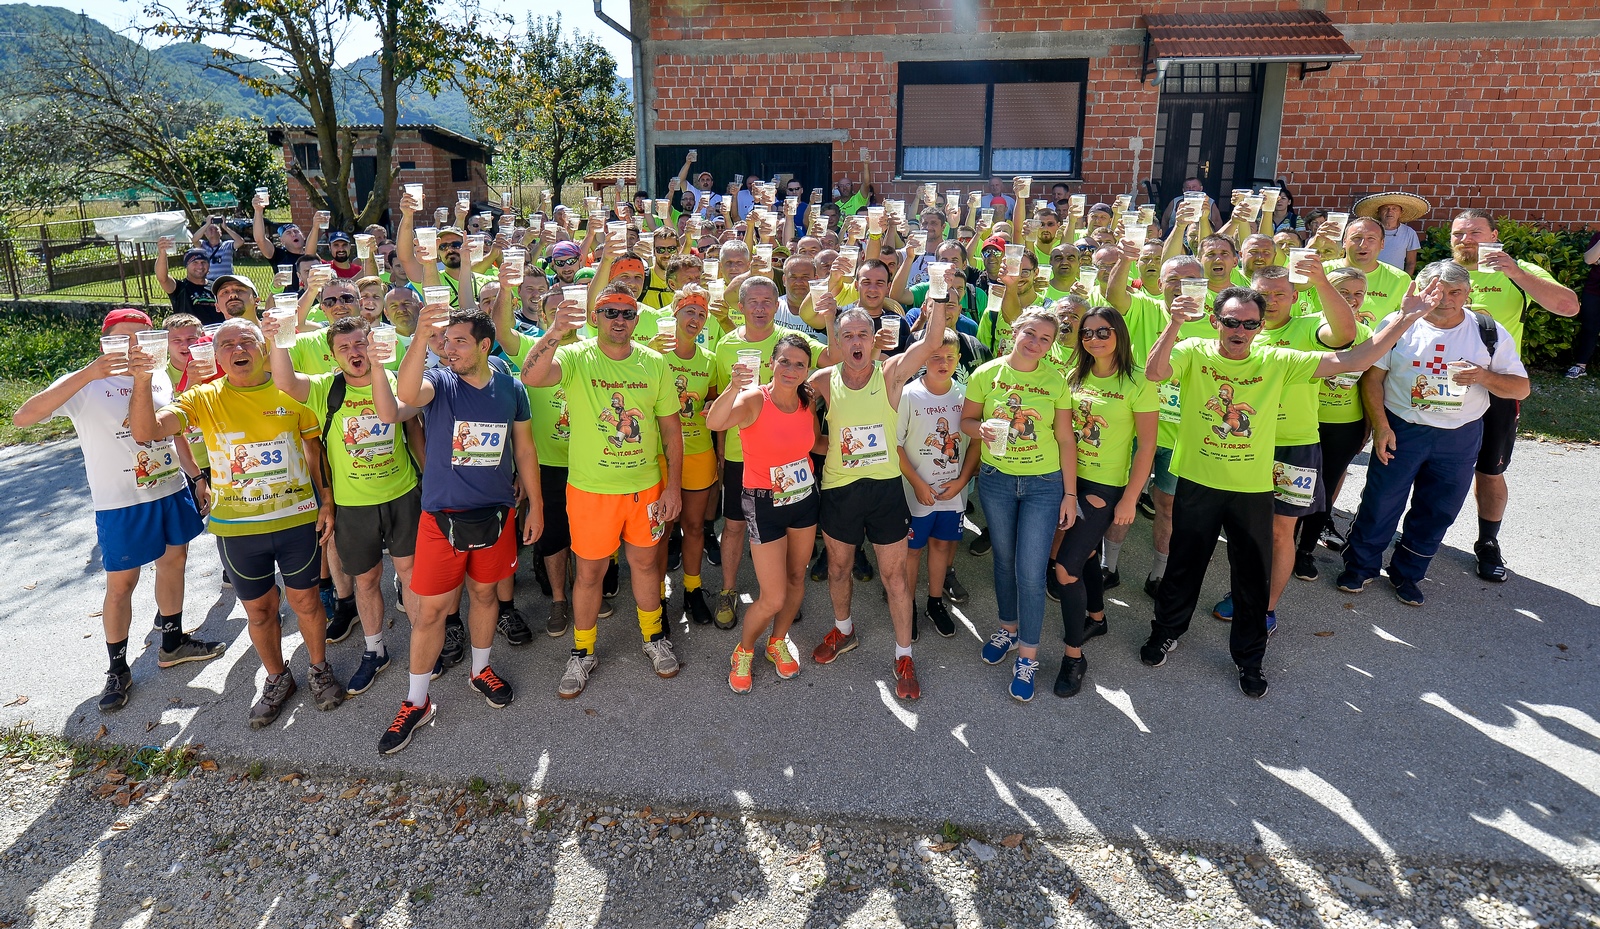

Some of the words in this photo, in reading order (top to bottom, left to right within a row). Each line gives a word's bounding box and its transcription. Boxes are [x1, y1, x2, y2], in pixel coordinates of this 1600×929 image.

[598, 379, 627, 390] "Opaka"
[370, 423, 390, 436] 47
[481, 432, 500, 446] 78
[868, 434, 878, 447] 2
[164, 452, 172, 466] 3
[260, 450, 282, 466] 33
[794, 468, 808, 484] 10
[1292, 476, 1312, 490] 42
[248, 494, 260, 502] und
[298, 501, 316, 512] swb
